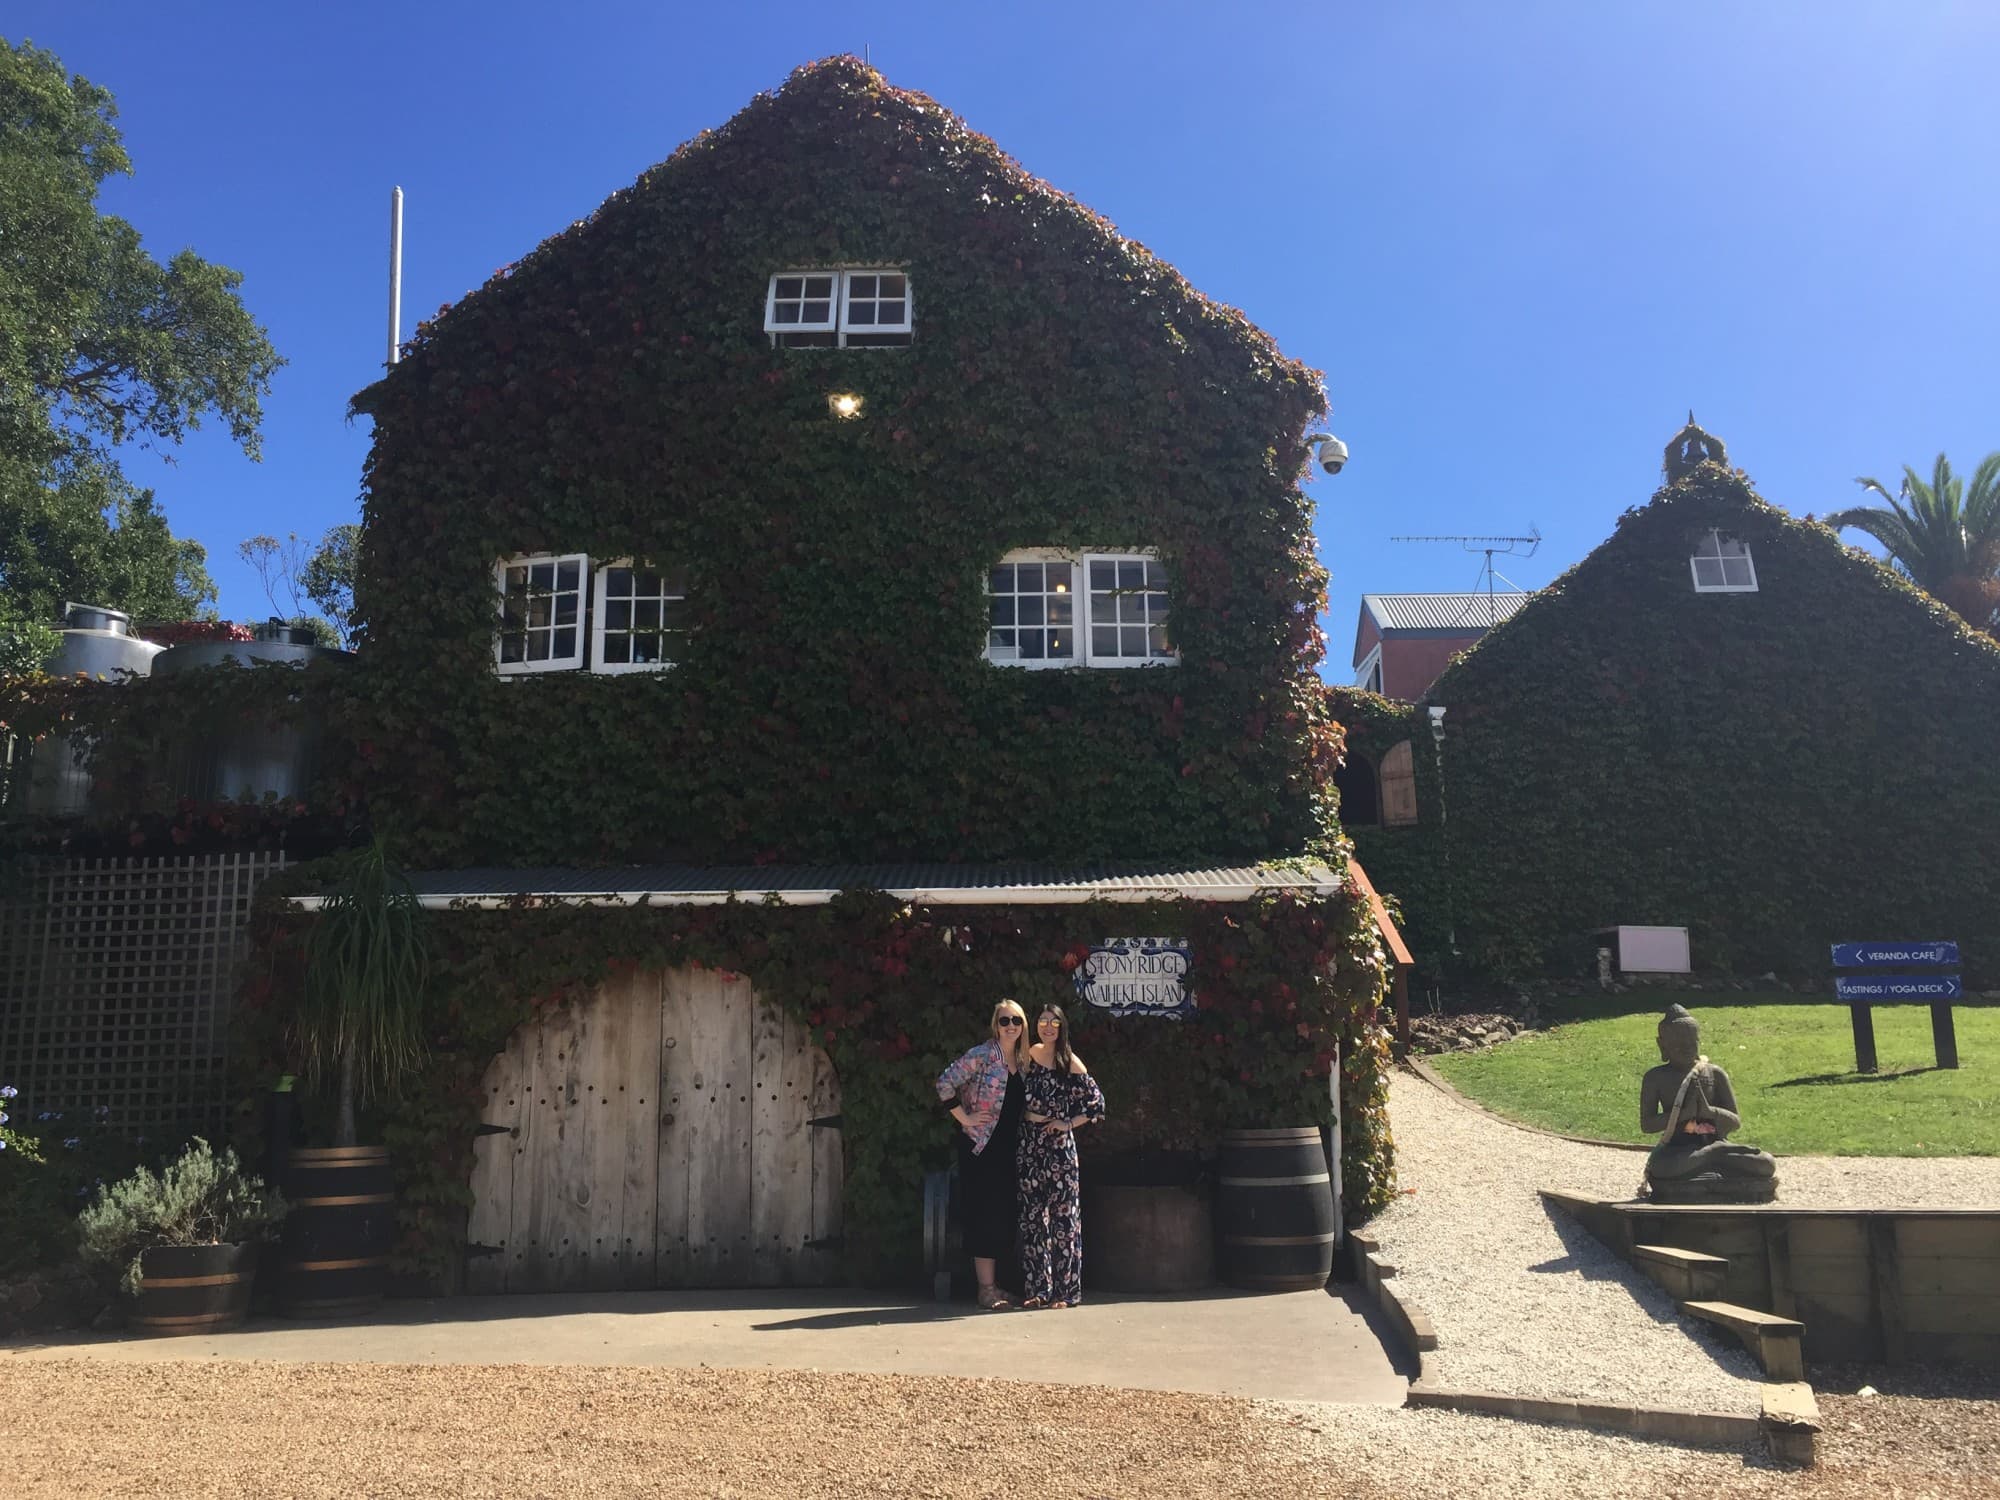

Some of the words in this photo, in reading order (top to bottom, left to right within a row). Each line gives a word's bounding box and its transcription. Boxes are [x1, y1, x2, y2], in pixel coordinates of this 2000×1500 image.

[1868, 952, 1910, 960] VERANDA
[1842, 985, 1883, 994] TASTINGS
[1889, 984, 1917, 993] YOGA
[1918, 984, 1944, 993] DECK
